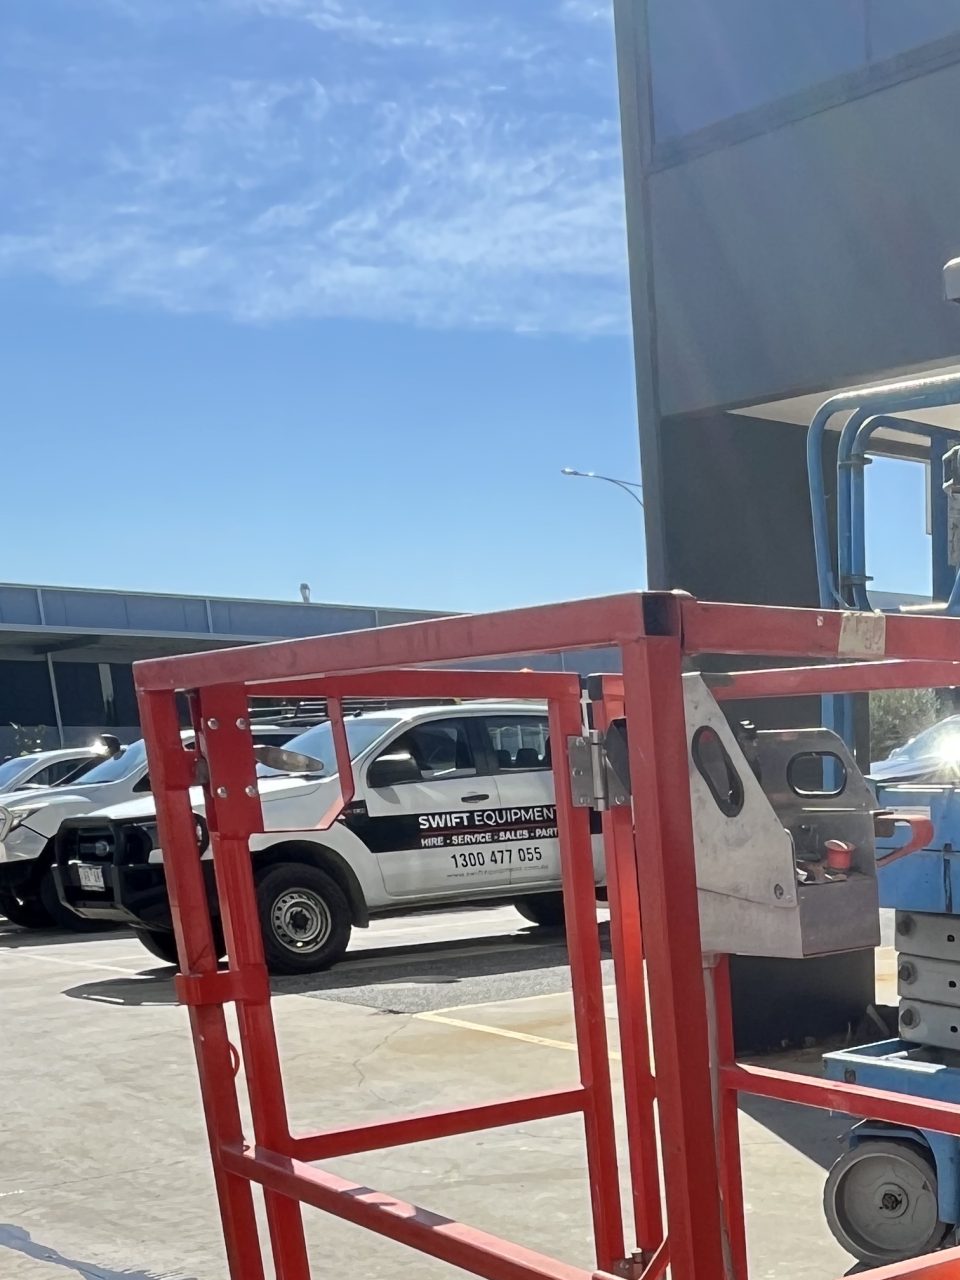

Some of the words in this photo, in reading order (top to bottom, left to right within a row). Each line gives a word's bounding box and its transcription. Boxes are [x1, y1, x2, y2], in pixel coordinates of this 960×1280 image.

[418, 812, 470, 829] SWIFT
[474, 807, 557, 825] EQUIPMEN
[421, 836, 444, 847] HIRE
[452, 833, 492, 845] SERVICE
[499, 829, 529, 840] SALES
[535, 827, 558, 838] PART
[451, 852, 485, 868] 1300
[490, 849, 512, 865] 477
[518, 847, 542, 862] 055
